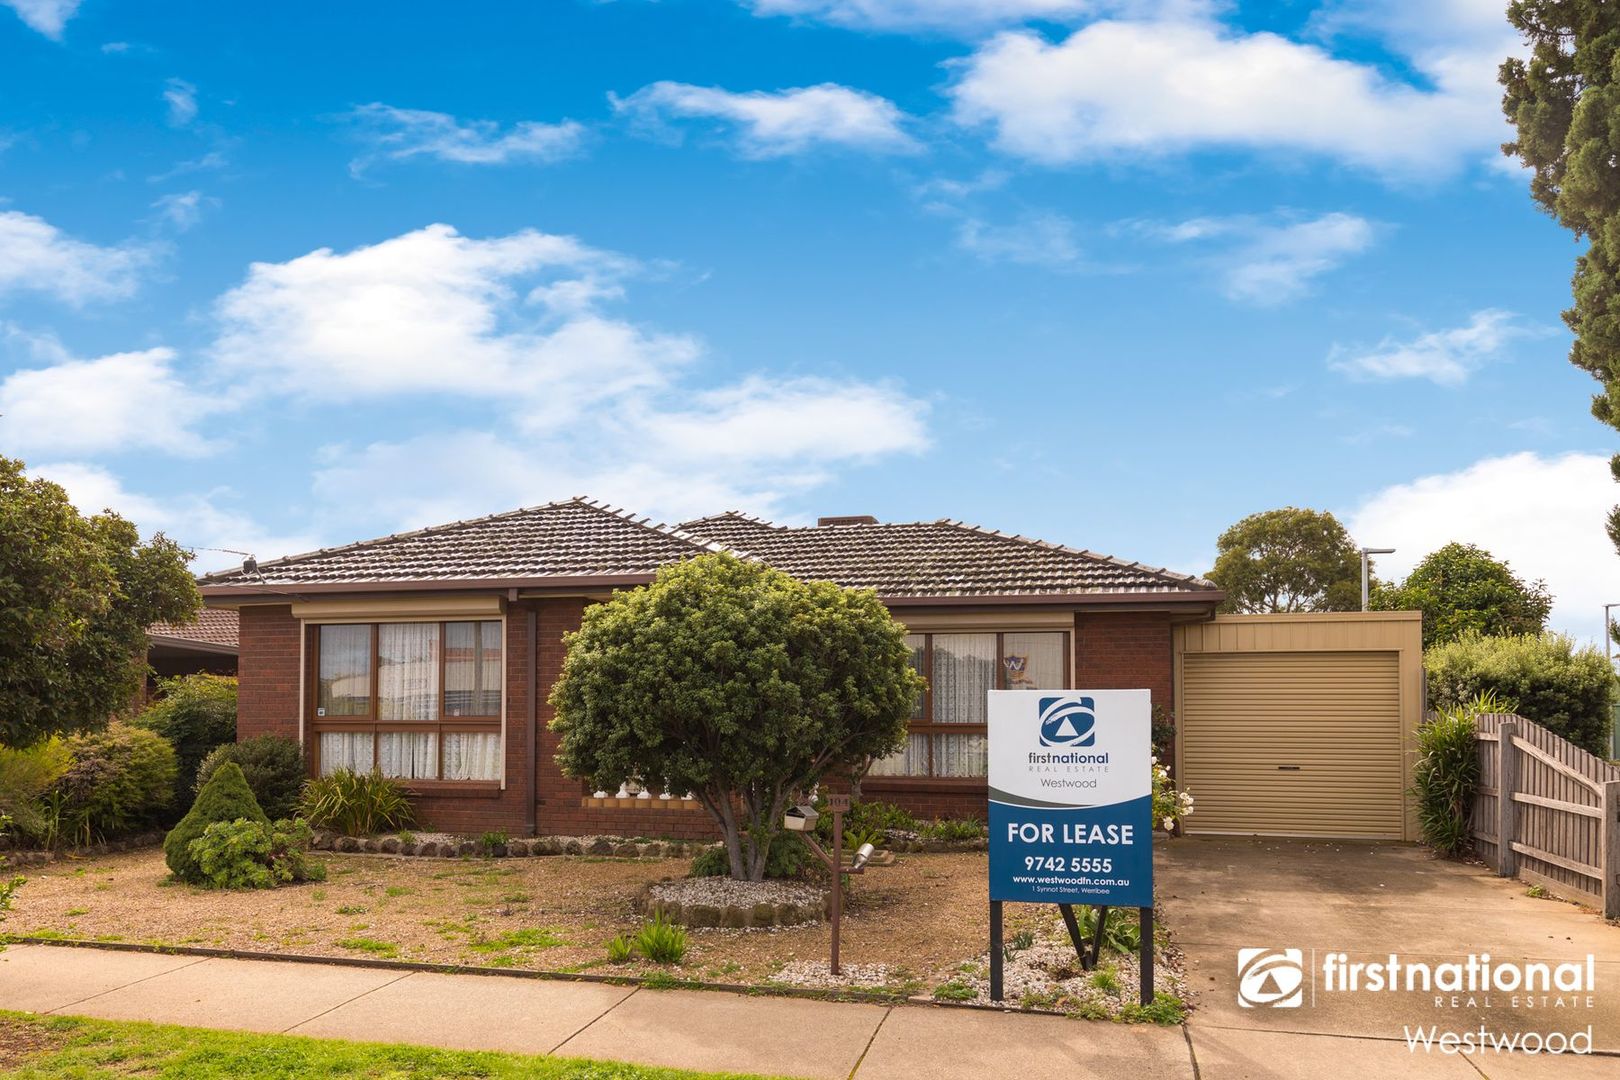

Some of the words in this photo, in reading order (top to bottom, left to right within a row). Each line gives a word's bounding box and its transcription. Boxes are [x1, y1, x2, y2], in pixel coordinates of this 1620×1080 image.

[1028, 752, 1109, 764] firstnational
[1067, 765, 1109, 773] ESTATE
[1040, 778, 1097, 788] Westwood
[1008, 823, 1054, 843] FOR
[1063, 824, 1134, 845] LEASE
[1024, 856, 1065, 872] 9742
[1070, 857, 1112, 873] 5555
[1012, 875, 1130, 886] www.westwoodfn.com.au
[1036, 886, 1058, 894] Synnot
